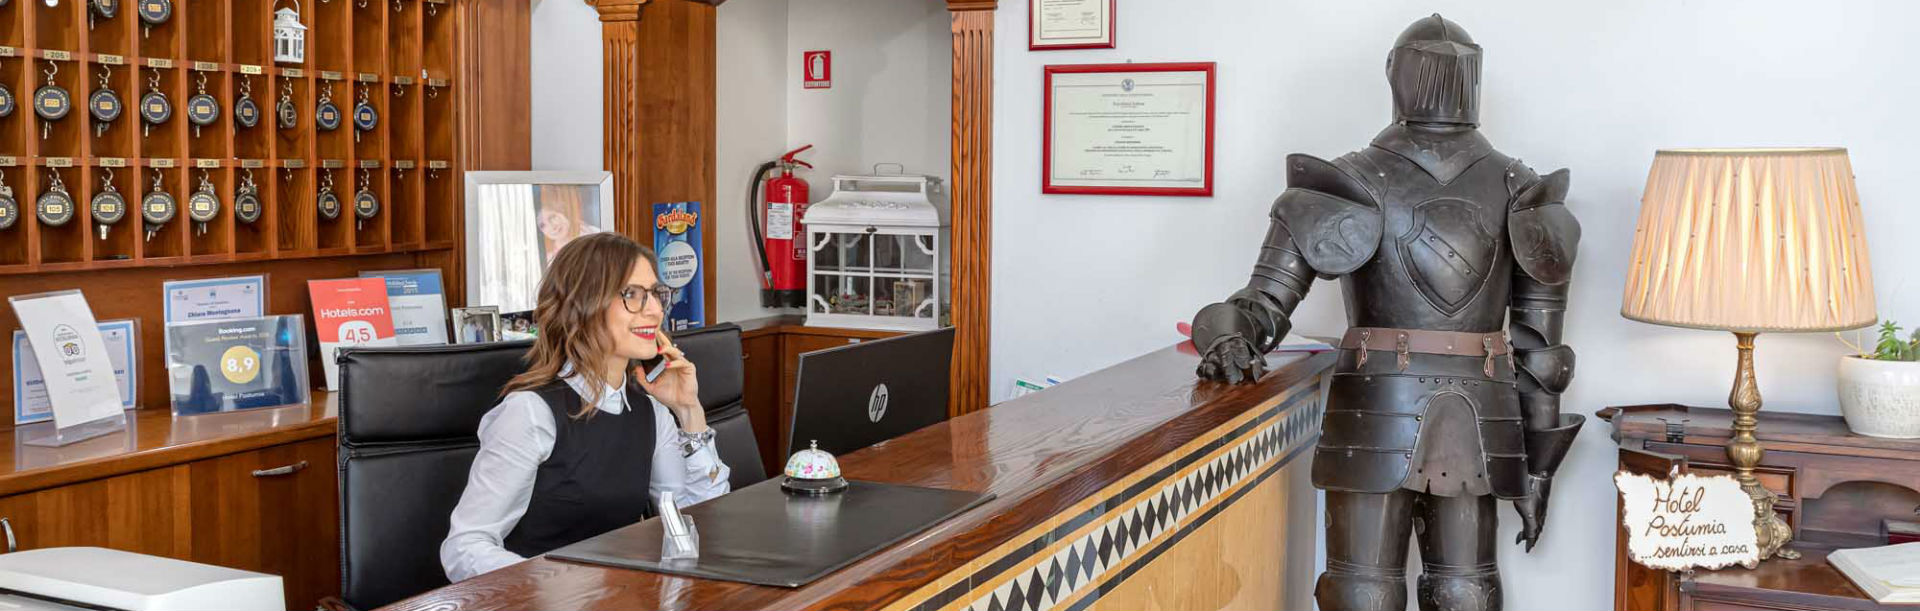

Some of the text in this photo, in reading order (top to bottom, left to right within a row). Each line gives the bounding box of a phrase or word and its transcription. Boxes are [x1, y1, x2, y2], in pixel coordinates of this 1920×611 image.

[320, 306, 384, 319] Hotels.com
[218, 327, 256, 335] Booking.com
[345, 327, 371, 344] 4,5
[226, 356, 254, 373] 8,9
[1653, 486, 1704, 513] Hotel
[1645, 514, 1726, 537] Postumia
[1641, 537, 1749, 559] ...sentirsi a casa
